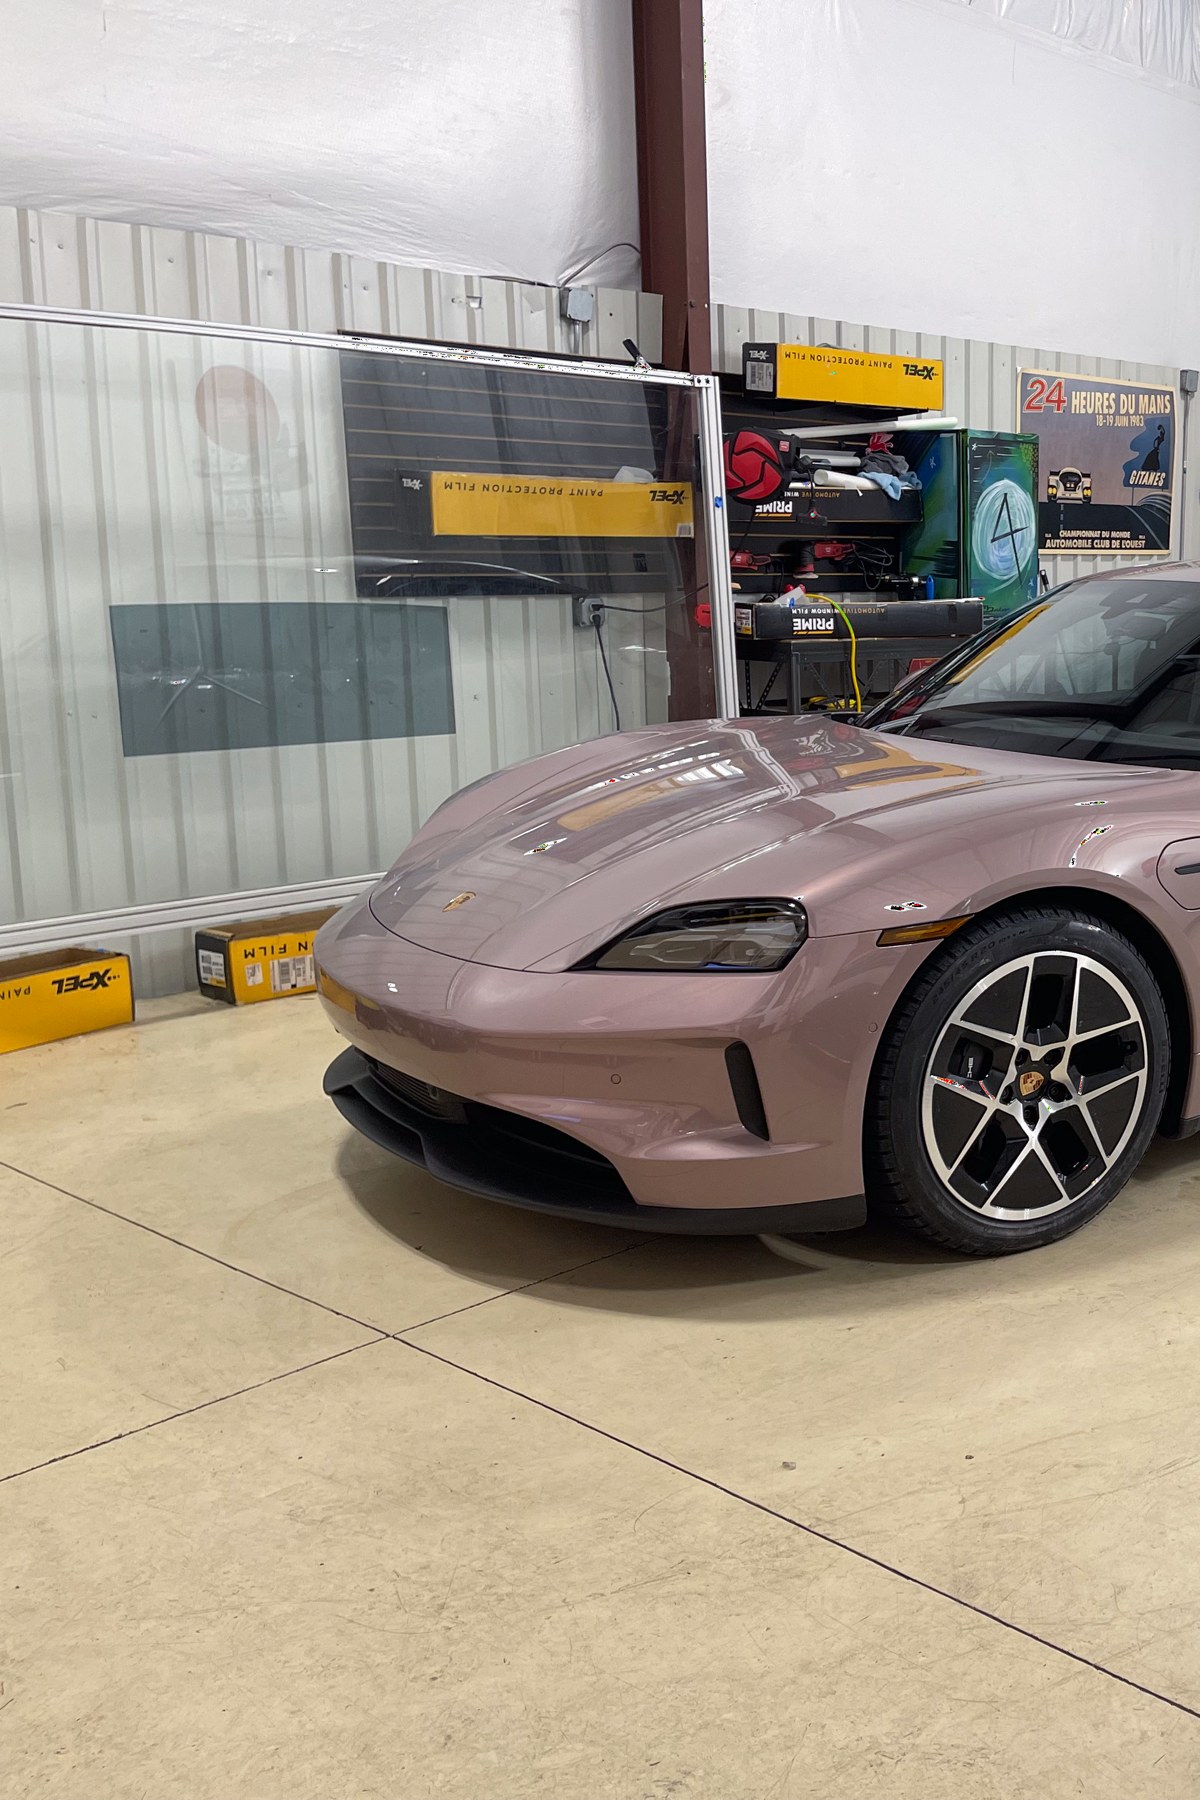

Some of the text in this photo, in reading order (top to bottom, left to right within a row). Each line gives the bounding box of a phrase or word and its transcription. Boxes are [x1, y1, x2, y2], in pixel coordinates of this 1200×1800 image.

[784, 351, 893, 369] PAINT PROTECTION FILM
[902, 363, 935, 380] XPEL
[1023, 376, 1171, 414] 24 HEURES DU MANS
[1096, 414, 1144, 427] 18-19 JUIN 1983
[1129, 470, 1166, 486] GITANES
[444, 481, 604, 497] PAINT PROTECTION FILM
[650, 490, 685, 505] XPEL
[755, 501, 793, 513] PRIME
[1059, 530, 1101, 538] CHAMPIONNAT
[1101, 530, 1110, 538] DU
[1111, 531, 1131, 539] MONDE
[1045, 539, 1146, 548] AUTOMOBILE CLUB DE L'OUEST
[793, 618, 834, 630] PRIME
[243, 943, 287, 959] FILM
[51, 968, 112, 995] XPEL
